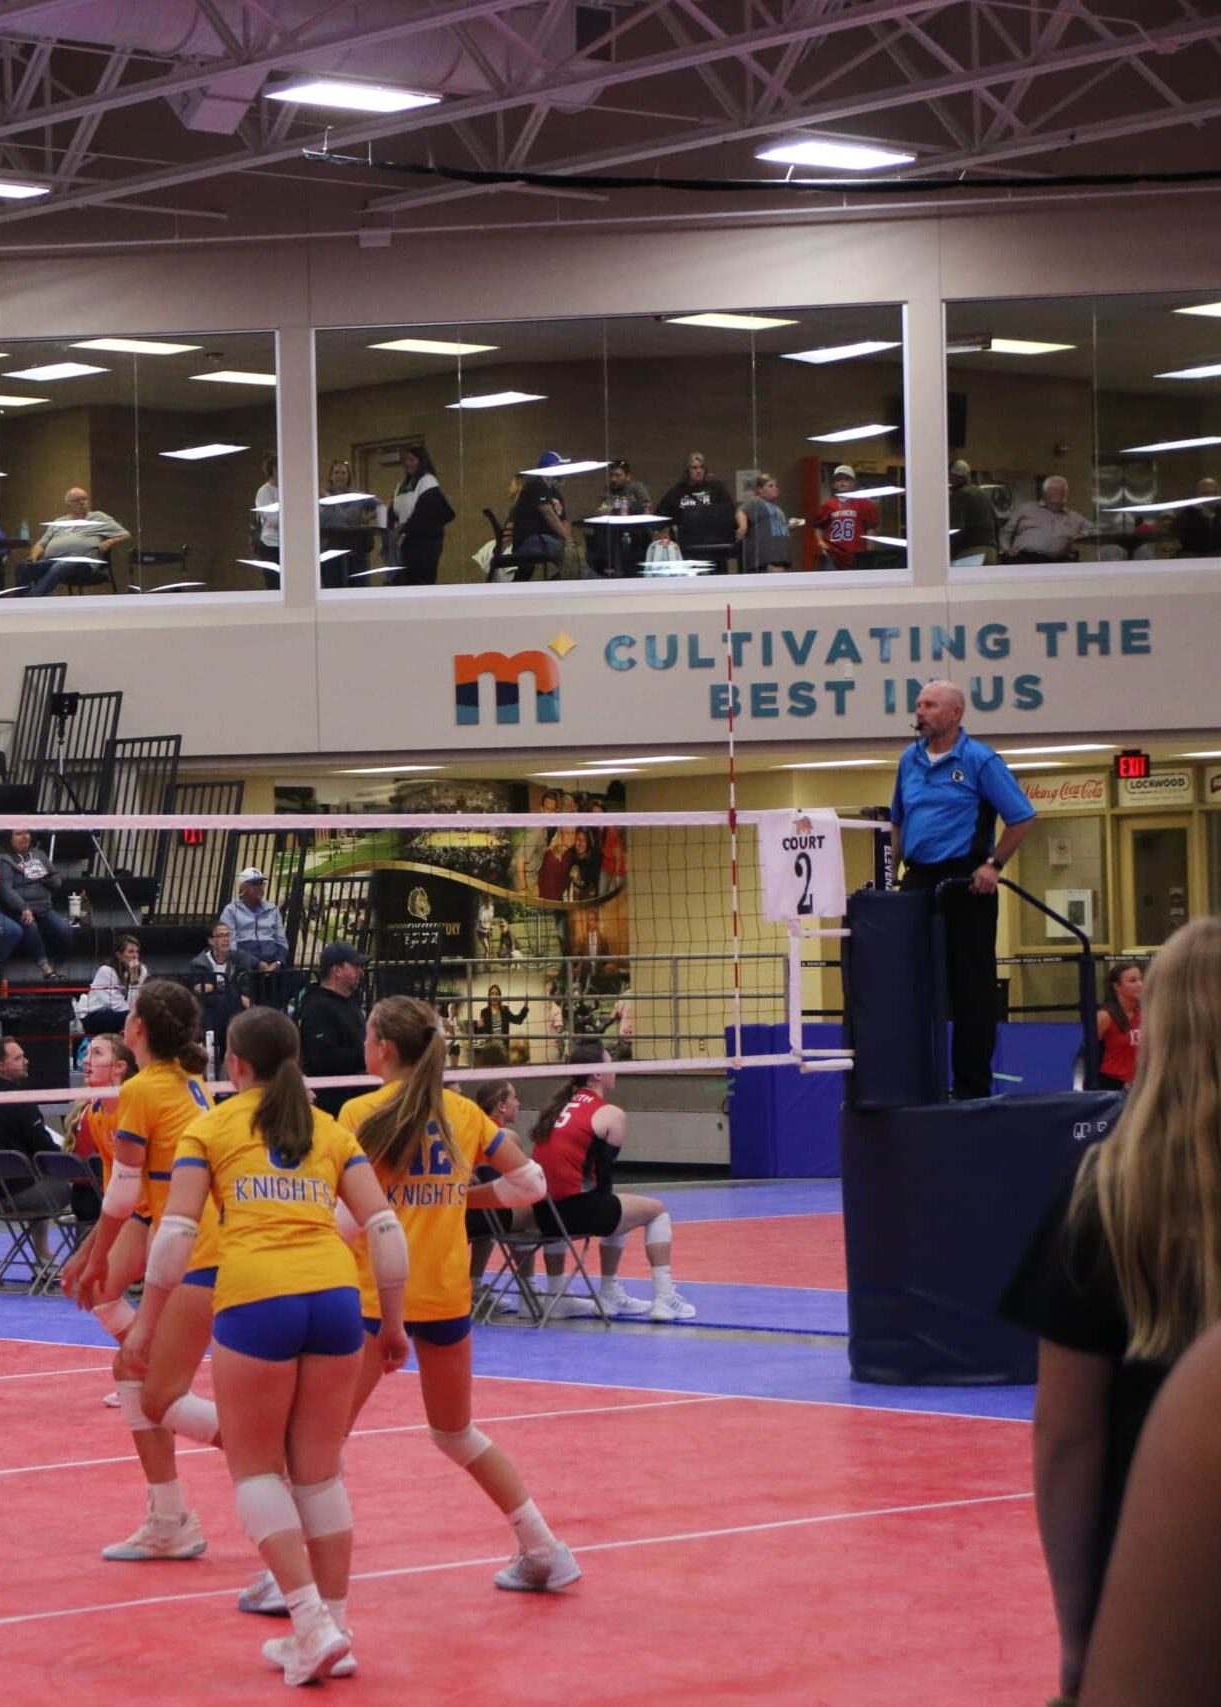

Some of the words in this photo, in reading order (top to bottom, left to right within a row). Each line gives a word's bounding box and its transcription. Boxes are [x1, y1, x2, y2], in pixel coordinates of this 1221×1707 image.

[831, 518, 855, 542] 26
[605, 624, 1010, 671] CULTIVATING
[1036, 619, 1152, 658] THE
[709, 680, 856, 719] BEST
[970, 674, 1044, 712] US
[1119, 756, 1147, 778] EXIT
[1130, 778, 1186, 790] LOCKWOOD
[782, 835, 826, 851] COURT
[794, 851, 814, 915] 2
[555, 1102, 581, 1128] 5
[234, 1175, 334, 1206] KNIGHTS
[386, 1183, 468, 1210] KNIGHTS
